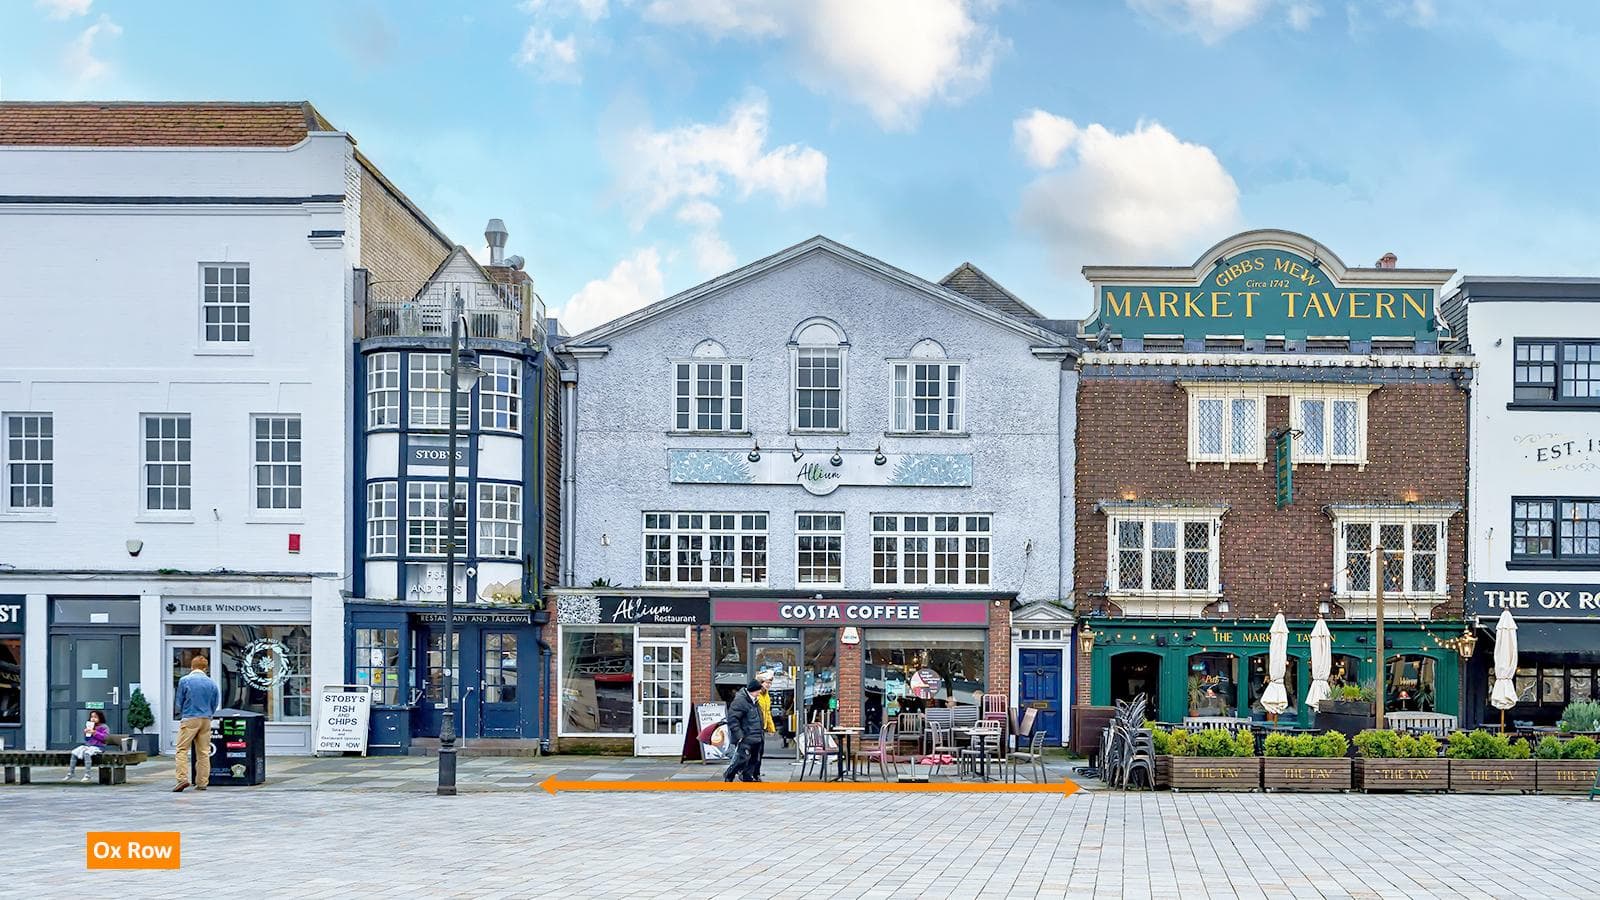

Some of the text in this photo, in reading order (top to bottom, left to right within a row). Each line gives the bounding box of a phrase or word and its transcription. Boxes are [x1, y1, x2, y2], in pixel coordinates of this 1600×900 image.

[1215, 257, 1320, 287] GIBBS MEW
[1245, 279, 1290, 289] Circa 1742
[1105, 291, 1427, 319] MARKET TAVERN
[415, 449, 462, 460] STOBS
[1536, 440, 1581, 462] EST.
[796, 462, 841, 482] Allium
[1483, 590, 1530, 609] THE
[1537, 590, 1571, 609] OX
[612, 597, 672, 623] Allium
[780, 604, 920, 621] COSTA COFFEE
[420, 614, 528, 623] RESTAUANT AND TAKEAWA
[653, 614, 697, 623] Restaurant
[1213, 632, 1233, 643] THE
[324, 695, 366, 703] STOBY'S
[333, 705, 356, 713] FISH
[328, 718, 358, 726] CHIPS
